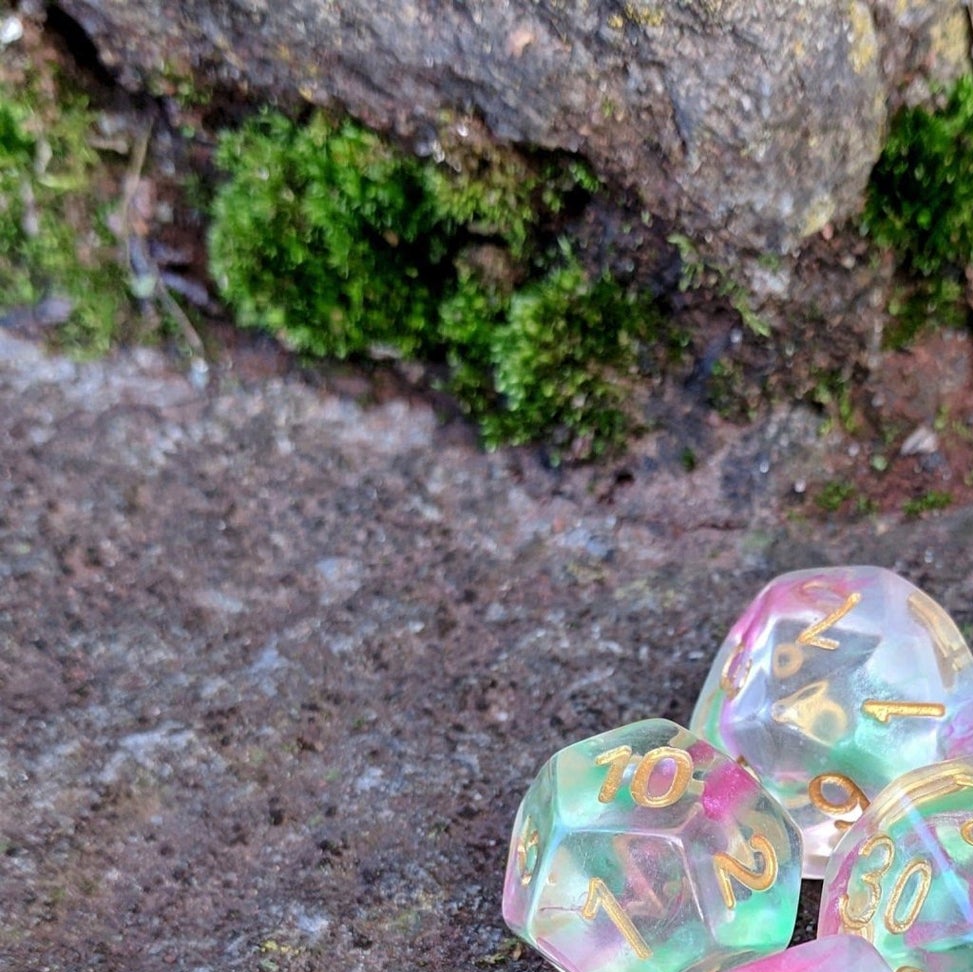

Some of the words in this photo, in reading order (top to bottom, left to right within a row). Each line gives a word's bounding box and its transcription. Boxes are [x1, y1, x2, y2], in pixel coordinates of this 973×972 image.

[595, 745, 693, 808] 10
[713, 834, 778, 909] 2
[838, 834, 933, 934] 30
